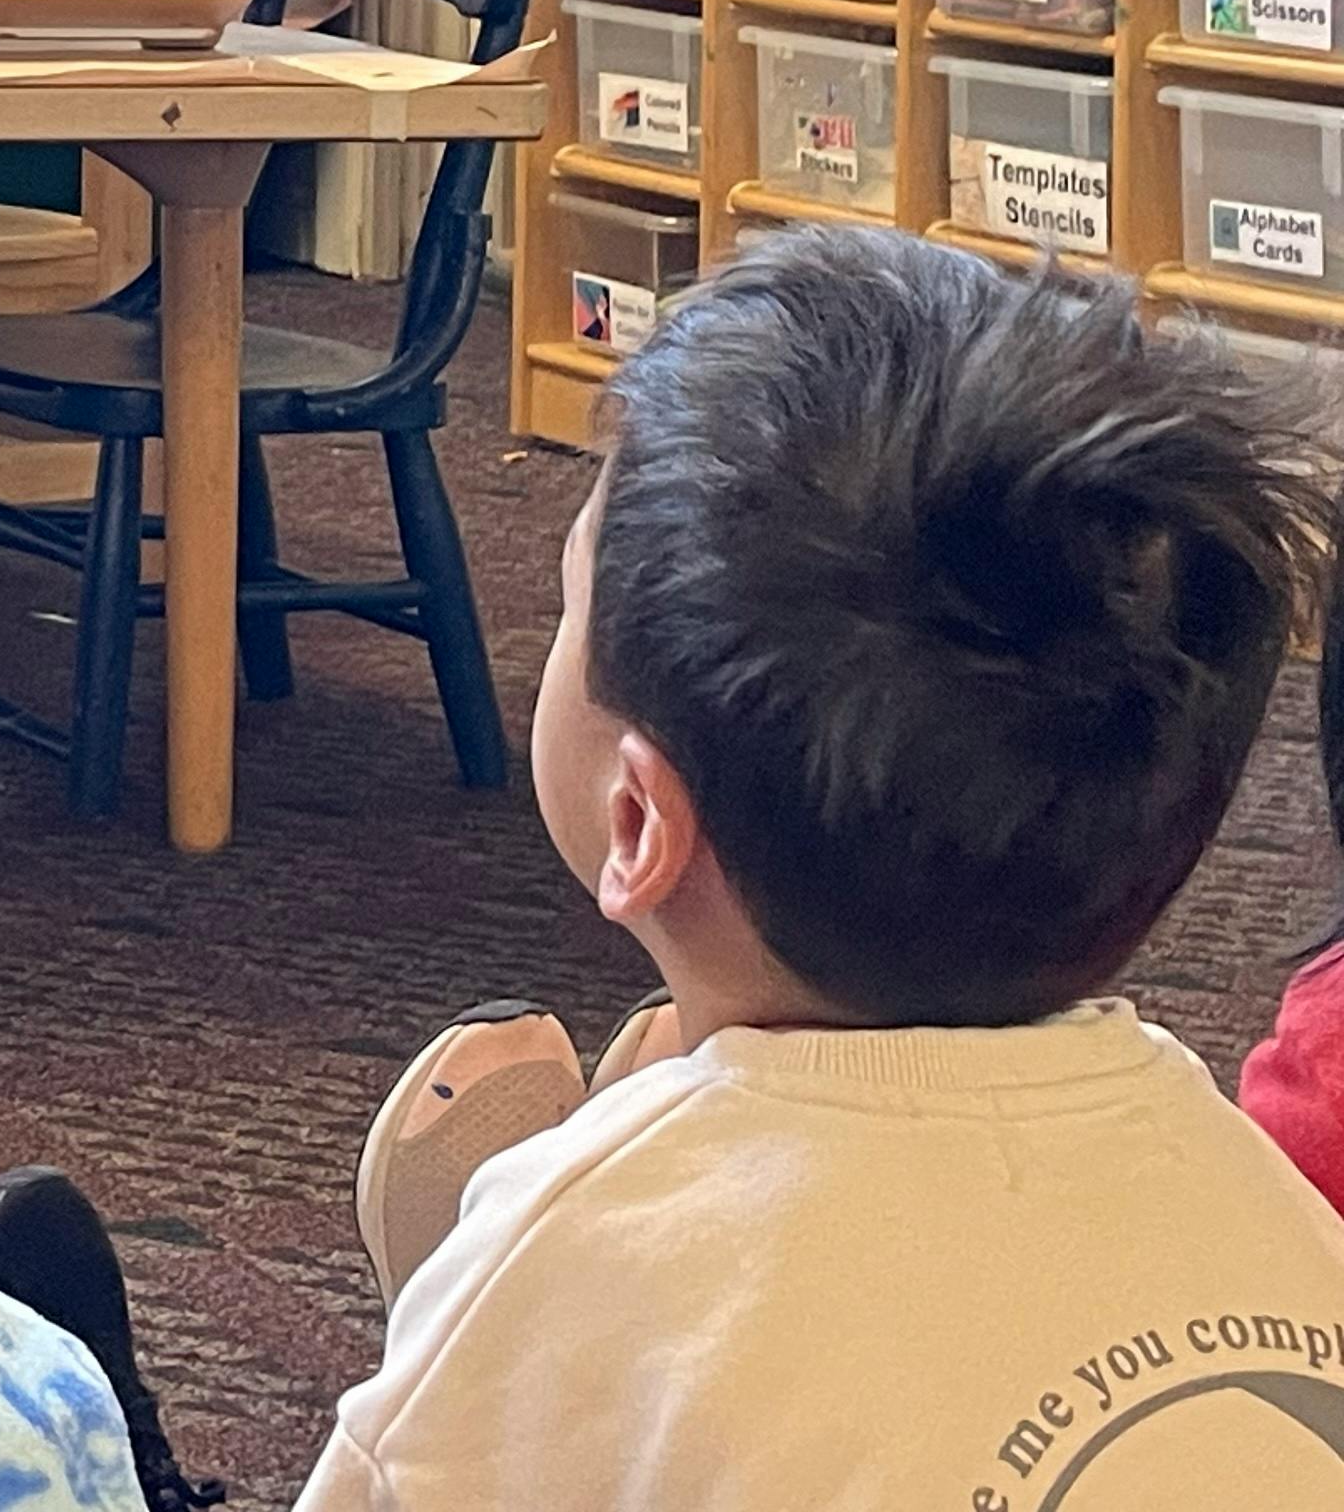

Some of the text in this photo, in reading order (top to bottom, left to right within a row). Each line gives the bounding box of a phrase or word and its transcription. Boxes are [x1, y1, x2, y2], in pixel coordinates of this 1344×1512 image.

[987, 152, 1107, 200] Templates
[1004, 195, 1096, 239] Stencils
[1239, 207, 1317, 238] Alphabet
[1252, 237, 1304, 264] Cards
[997, 1391, 1075, 1479] me
[1072, 1329, 1175, 1412] you
